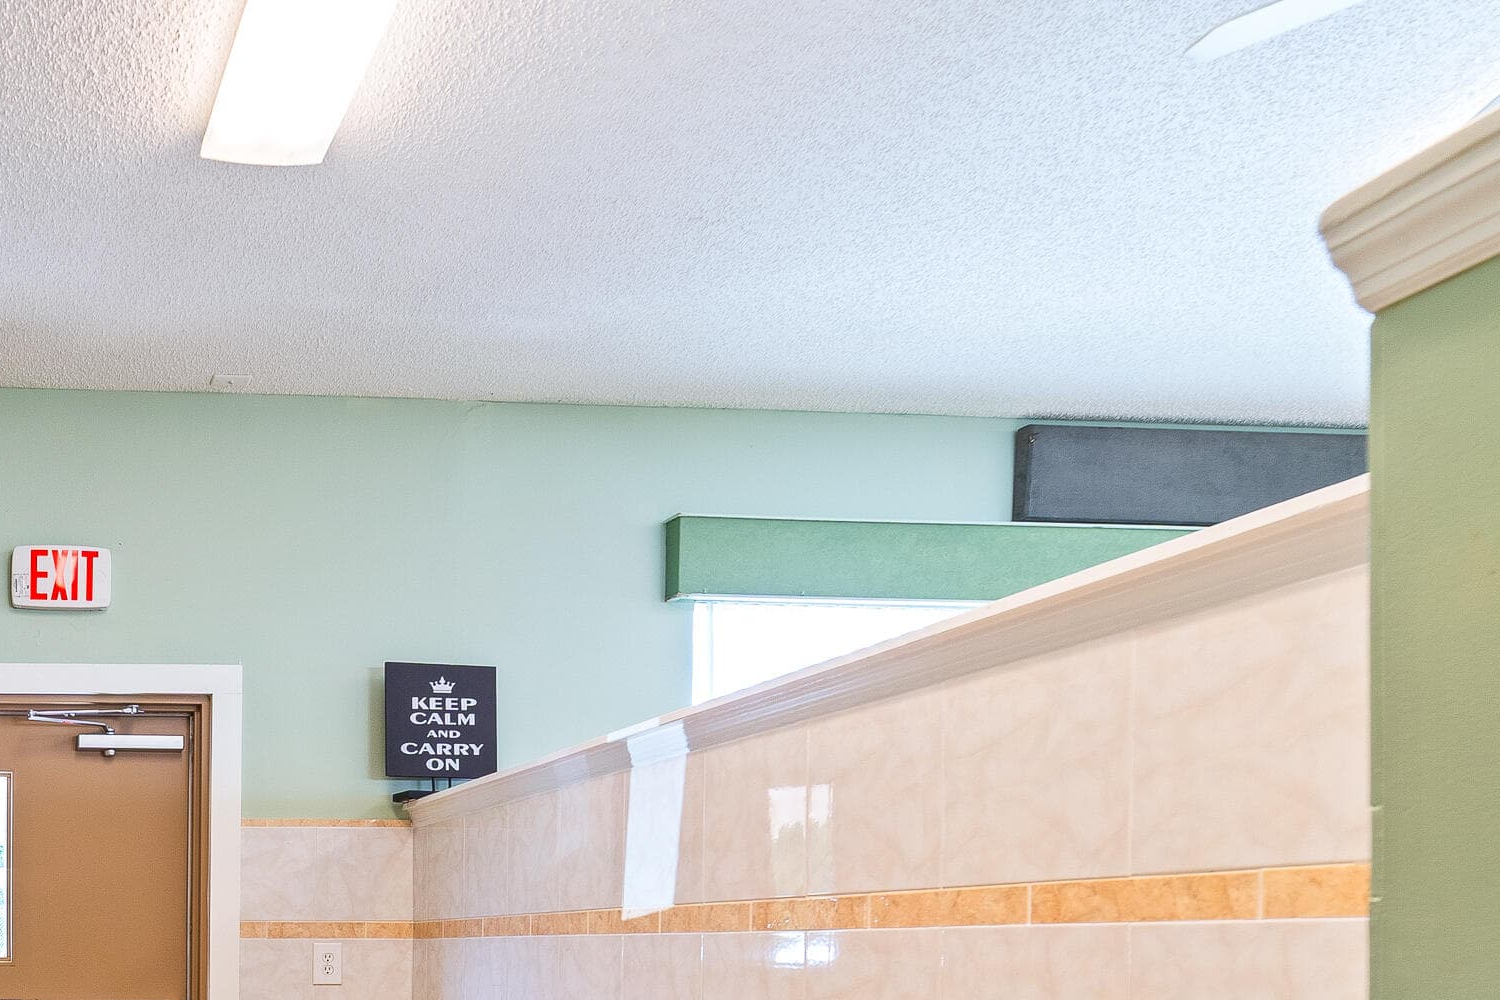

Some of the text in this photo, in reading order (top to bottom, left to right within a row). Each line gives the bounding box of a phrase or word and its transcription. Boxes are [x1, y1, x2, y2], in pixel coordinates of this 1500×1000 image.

[30, 549, 99, 601] EXIT
[411, 696, 477, 711] KEEP
[409, 712, 476, 726] CALM
[427, 729, 461, 739] AND
[400, 742, 484, 756] CARRY
[425, 758, 460, 771] ON
